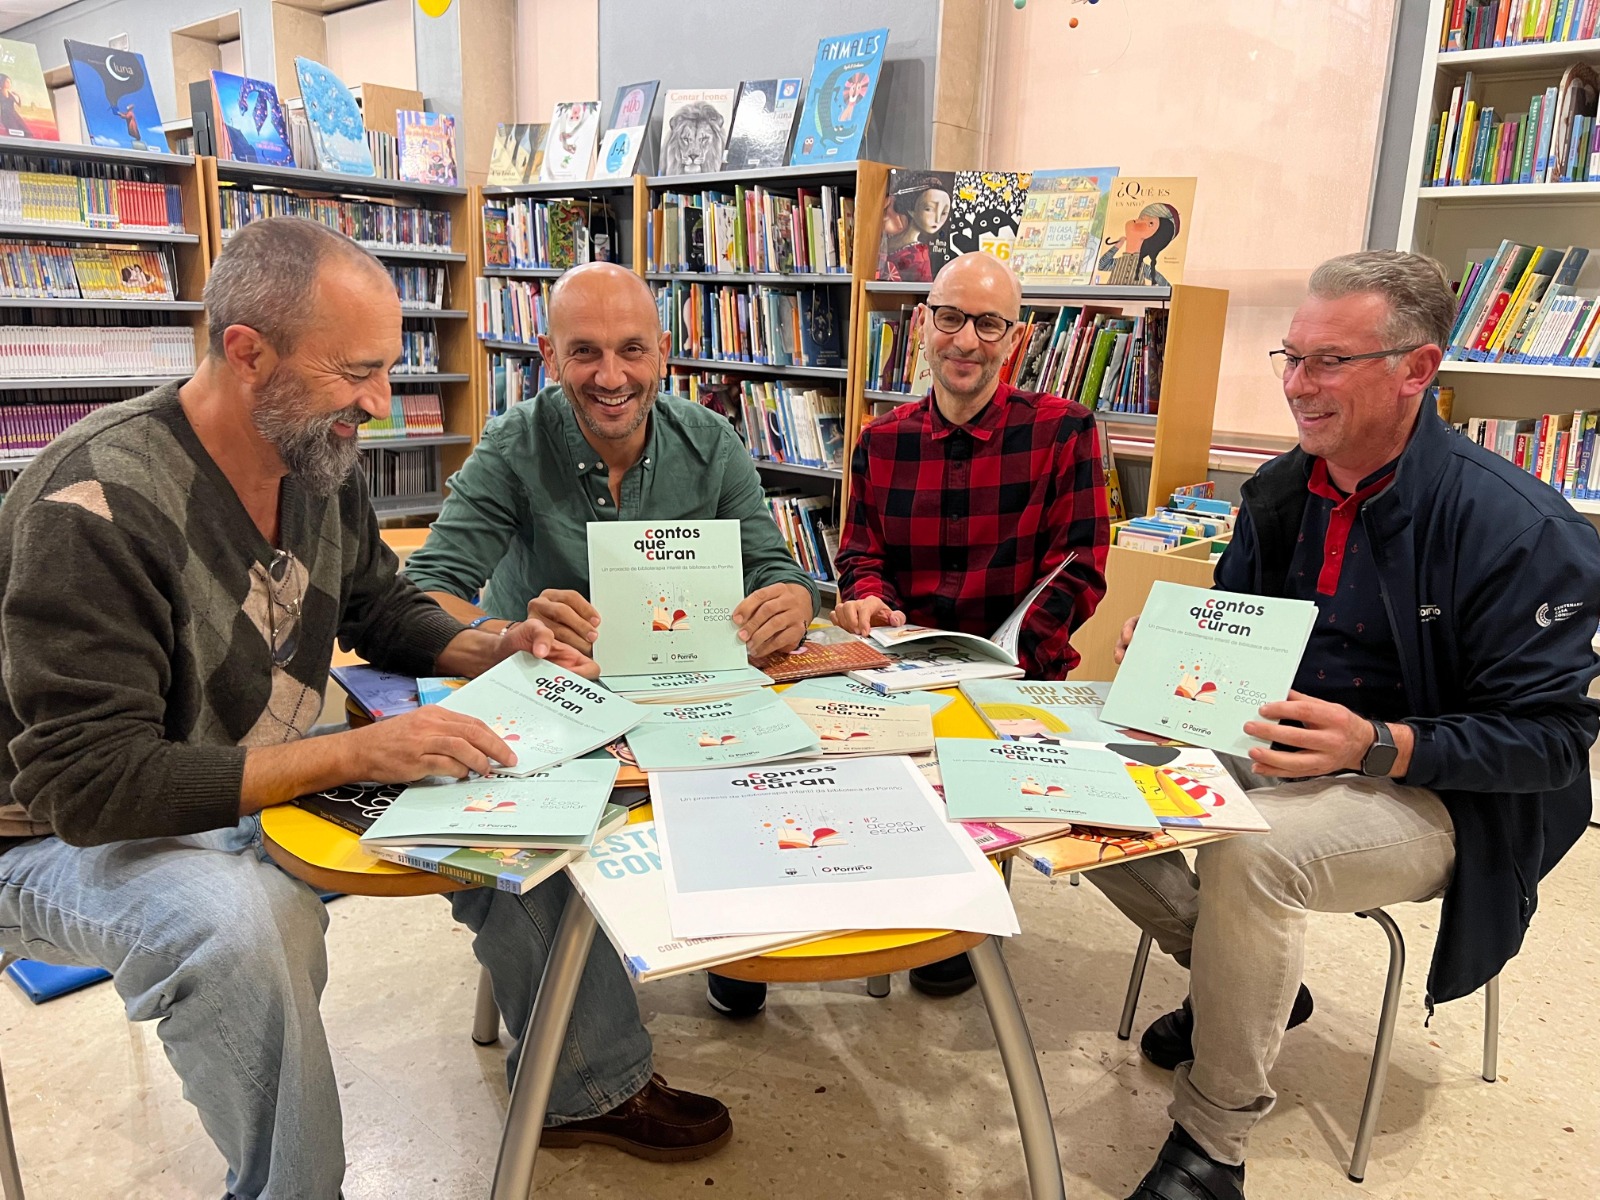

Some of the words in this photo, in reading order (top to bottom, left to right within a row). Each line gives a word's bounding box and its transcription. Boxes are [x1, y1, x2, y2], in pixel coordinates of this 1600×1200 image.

[822, 35, 880, 61] ANIMALES
[113, 62, 134, 76] luna
[671, 93, 699, 101] Contar
[702, 92, 728, 101] leones
[1158, 188, 1170, 196] ES
[645, 526, 700, 539] contos
[634, 538, 665, 552] que
[646, 548, 696, 560] curan
[1206, 598, 1265, 616] contos
[1190, 605, 1223, 621] que
[1198, 619, 1251, 637] curan
[652, 672, 701, 681] curan
[535, 676, 566, 695] que
[652, 679, 708, 687] contos
[554, 676, 606, 704] contos
[1016, 686, 1057, 695] HOY
[1064, 686, 1096, 695] NO
[1237, 688, 1267, 699] acoso
[536, 687, 584, 715] curan
[1031, 696, 1105, 705] JUEGAS
[1234, 695, 1268, 706] escola
[674, 702, 732, 712] contos
[816, 704, 849, 712] que
[828, 702, 886, 711] contos
[663, 710, 697, 718] que
[678, 710, 732, 720] curan
[827, 709, 880, 717] curan
[1189, 724, 1212, 736] Porriño
[990, 747, 1028, 756] que
[1002, 744, 1069, 756] contos
[1005, 753, 1066, 765] curan
[747, 765, 837, 779] contos
[731, 777, 783, 788] que
[752, 776, 835, 791] curan
[866, 821, 914, 829] acoso
[870, 826, 926, 836] escolar
[658, 942, 683, 953] CORI
